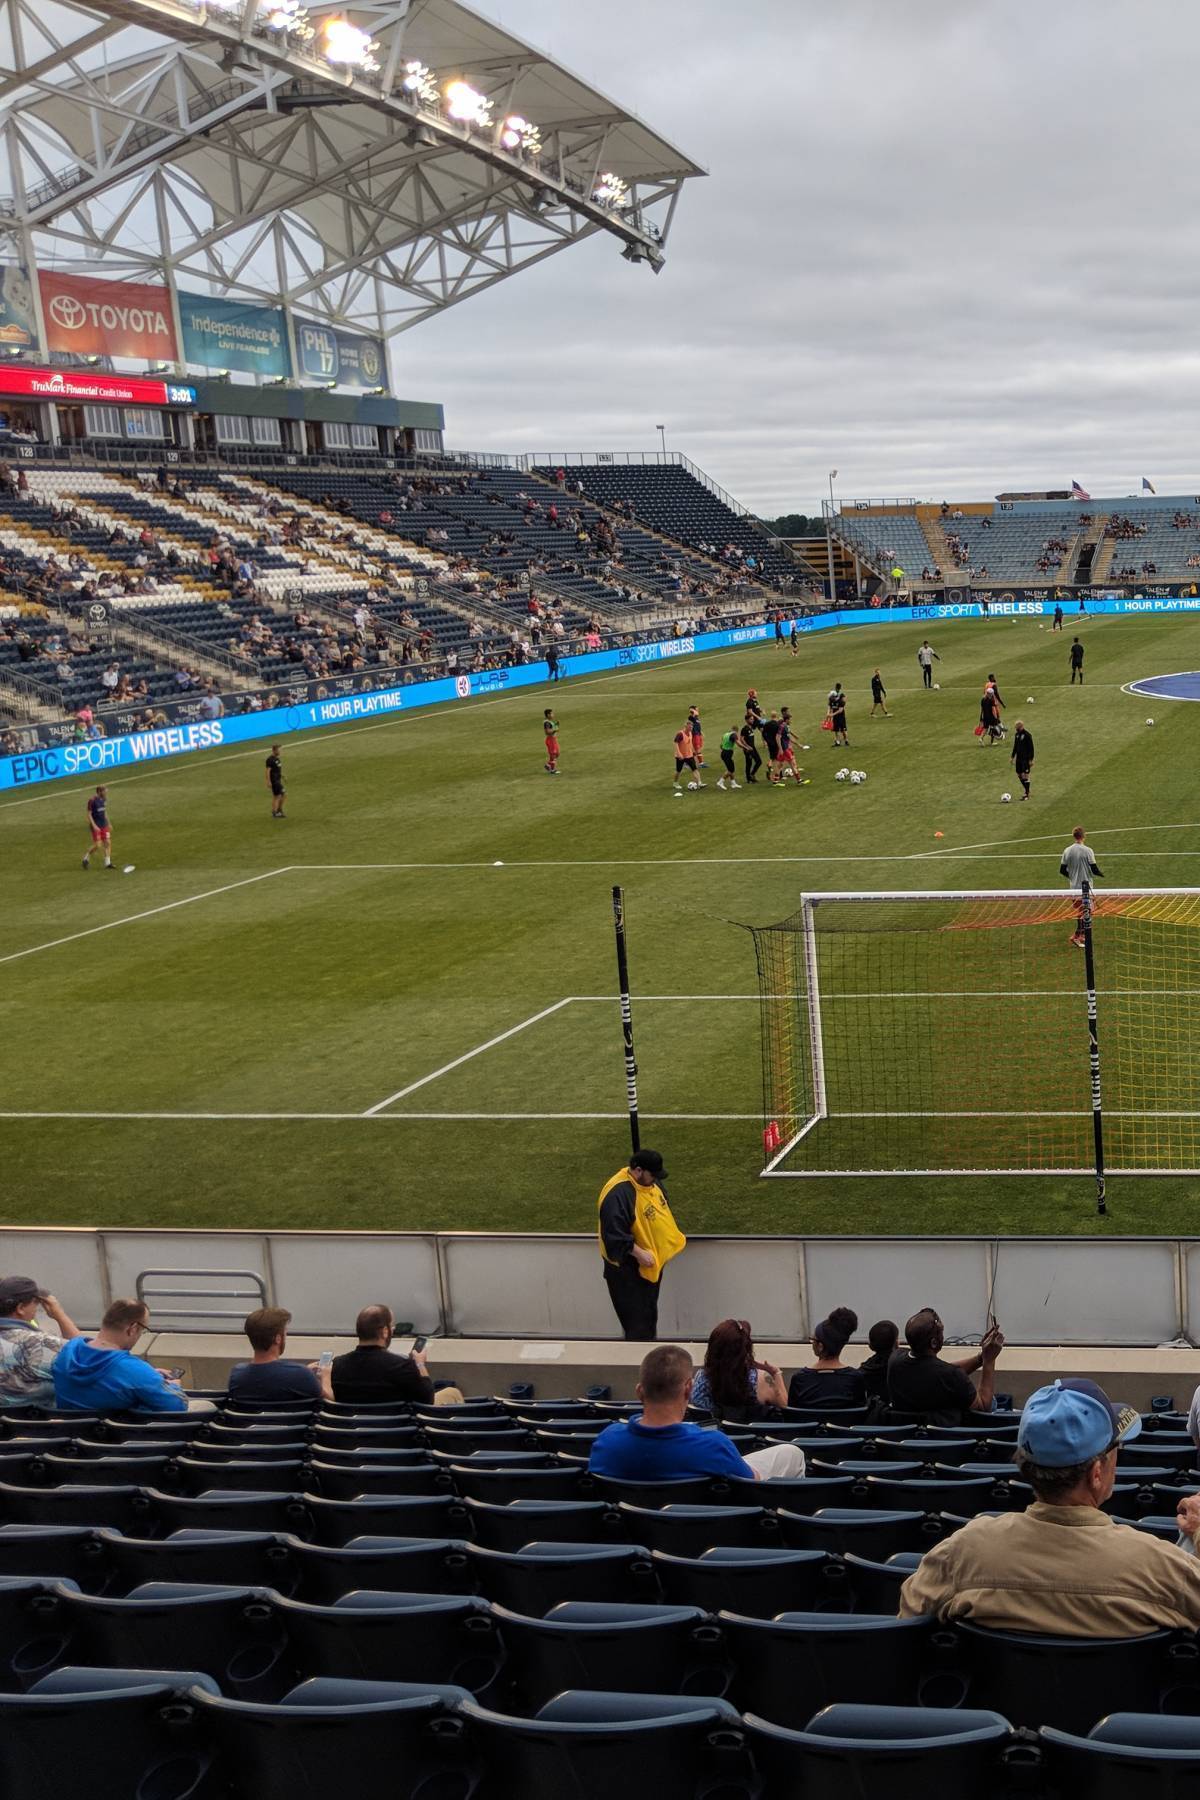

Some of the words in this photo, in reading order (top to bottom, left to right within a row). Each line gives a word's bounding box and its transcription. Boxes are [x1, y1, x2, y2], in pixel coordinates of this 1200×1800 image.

[86, 303, 169, 336] TOYOTA
[192, 315, 270, 343] Independence
[305, 330, 334, 353] PHL
[320, 353, 333, 372] 17
[32, 380, 65, 393] TruMark
[66, 383, 99, 396] Financial
[99, 388, 116, 397] Credit
[117, 390, 133, 399] Union
[20, 447, 34, 457] 128
[911, 607, 936, 619] EPIC
[937, 603, 976, 617] SPORT
[978, 602, 1044, 615] WIRELESS
[1125, 601, 1153, 610] HOUR
[733, 631, 748, 641] HOUR
[619, 650, 635, 664] EPIC
[636, 645, 659, 662] SPORT
[660, 639, 695, 657] WIRELESS
[310, 708, 316, 721] 1
[321, 702, 351, 720] HOUR
[353, 692, 402, 714] PLAYTIME
[11, 752, 60, 784] EPIC
[63, 738, 125, 773] SPORT
[130, 722, 224, 760] WIRELESS
